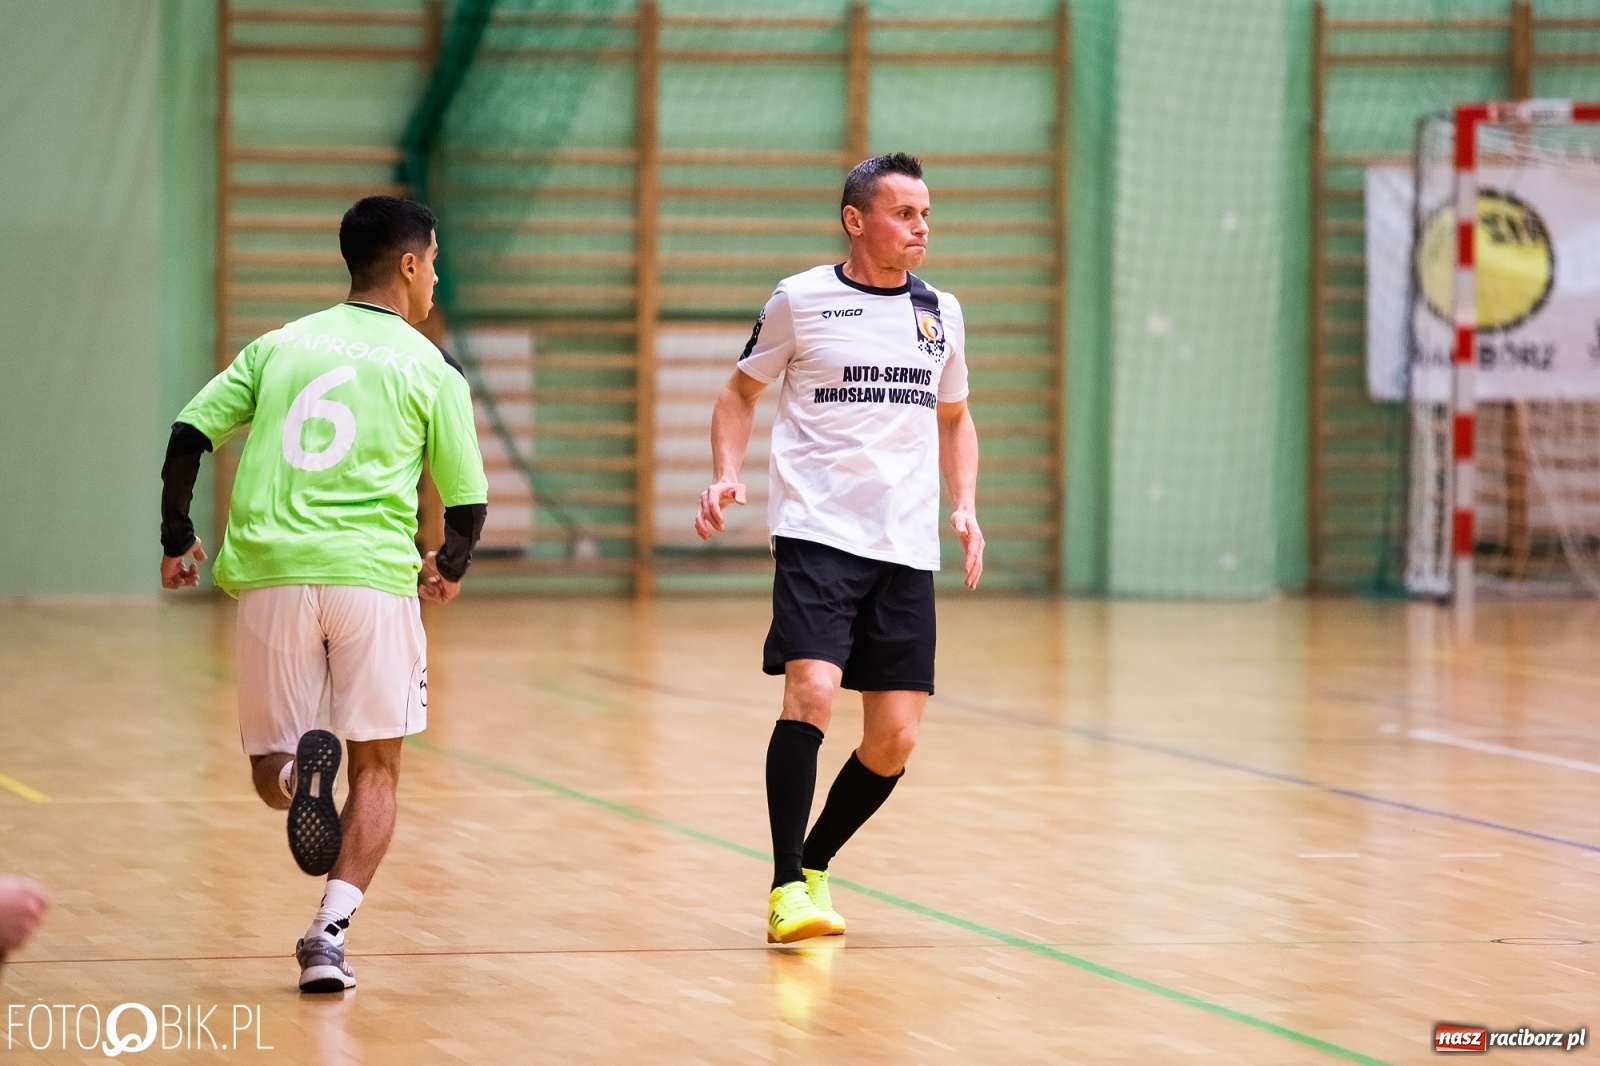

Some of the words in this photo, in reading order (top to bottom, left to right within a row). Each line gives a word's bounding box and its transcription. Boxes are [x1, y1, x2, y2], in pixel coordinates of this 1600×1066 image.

[278, 333, 421, 374] PAPROCKI
[842, 366, 932, 386] AUTO-SERWIS
[814, 387, 886, 404] MIROSŁAW
[282, 365, 357, 472] 6
